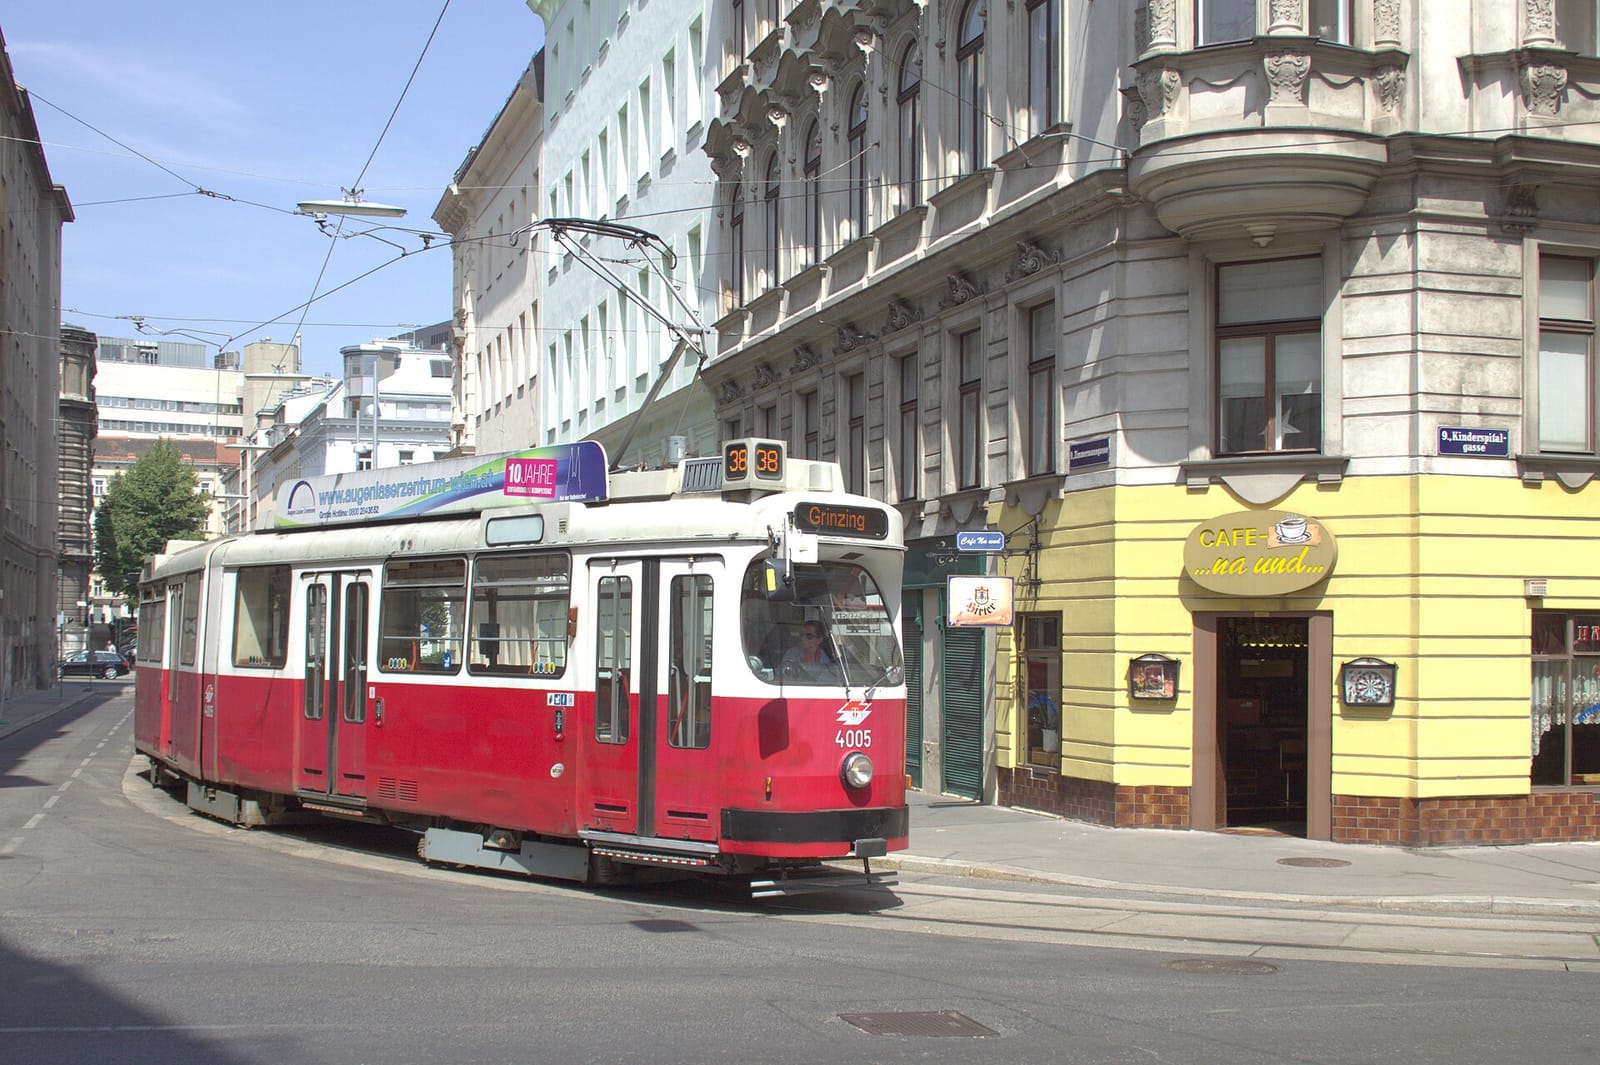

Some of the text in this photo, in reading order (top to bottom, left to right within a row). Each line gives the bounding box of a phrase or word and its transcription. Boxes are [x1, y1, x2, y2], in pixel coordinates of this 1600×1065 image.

[1462, 444, 1487, 453] gasse
[729, 449, 747, 472] 38
[756, 449, 779, 472] 38
[508, 463, 554, 485] 10 JAHRE
[318, 468, 494, 505] www.augenlaserzentrum-wien.at
[809, 506, 865, 531] Grinzing
[835, 729, 872, 748] 4005
